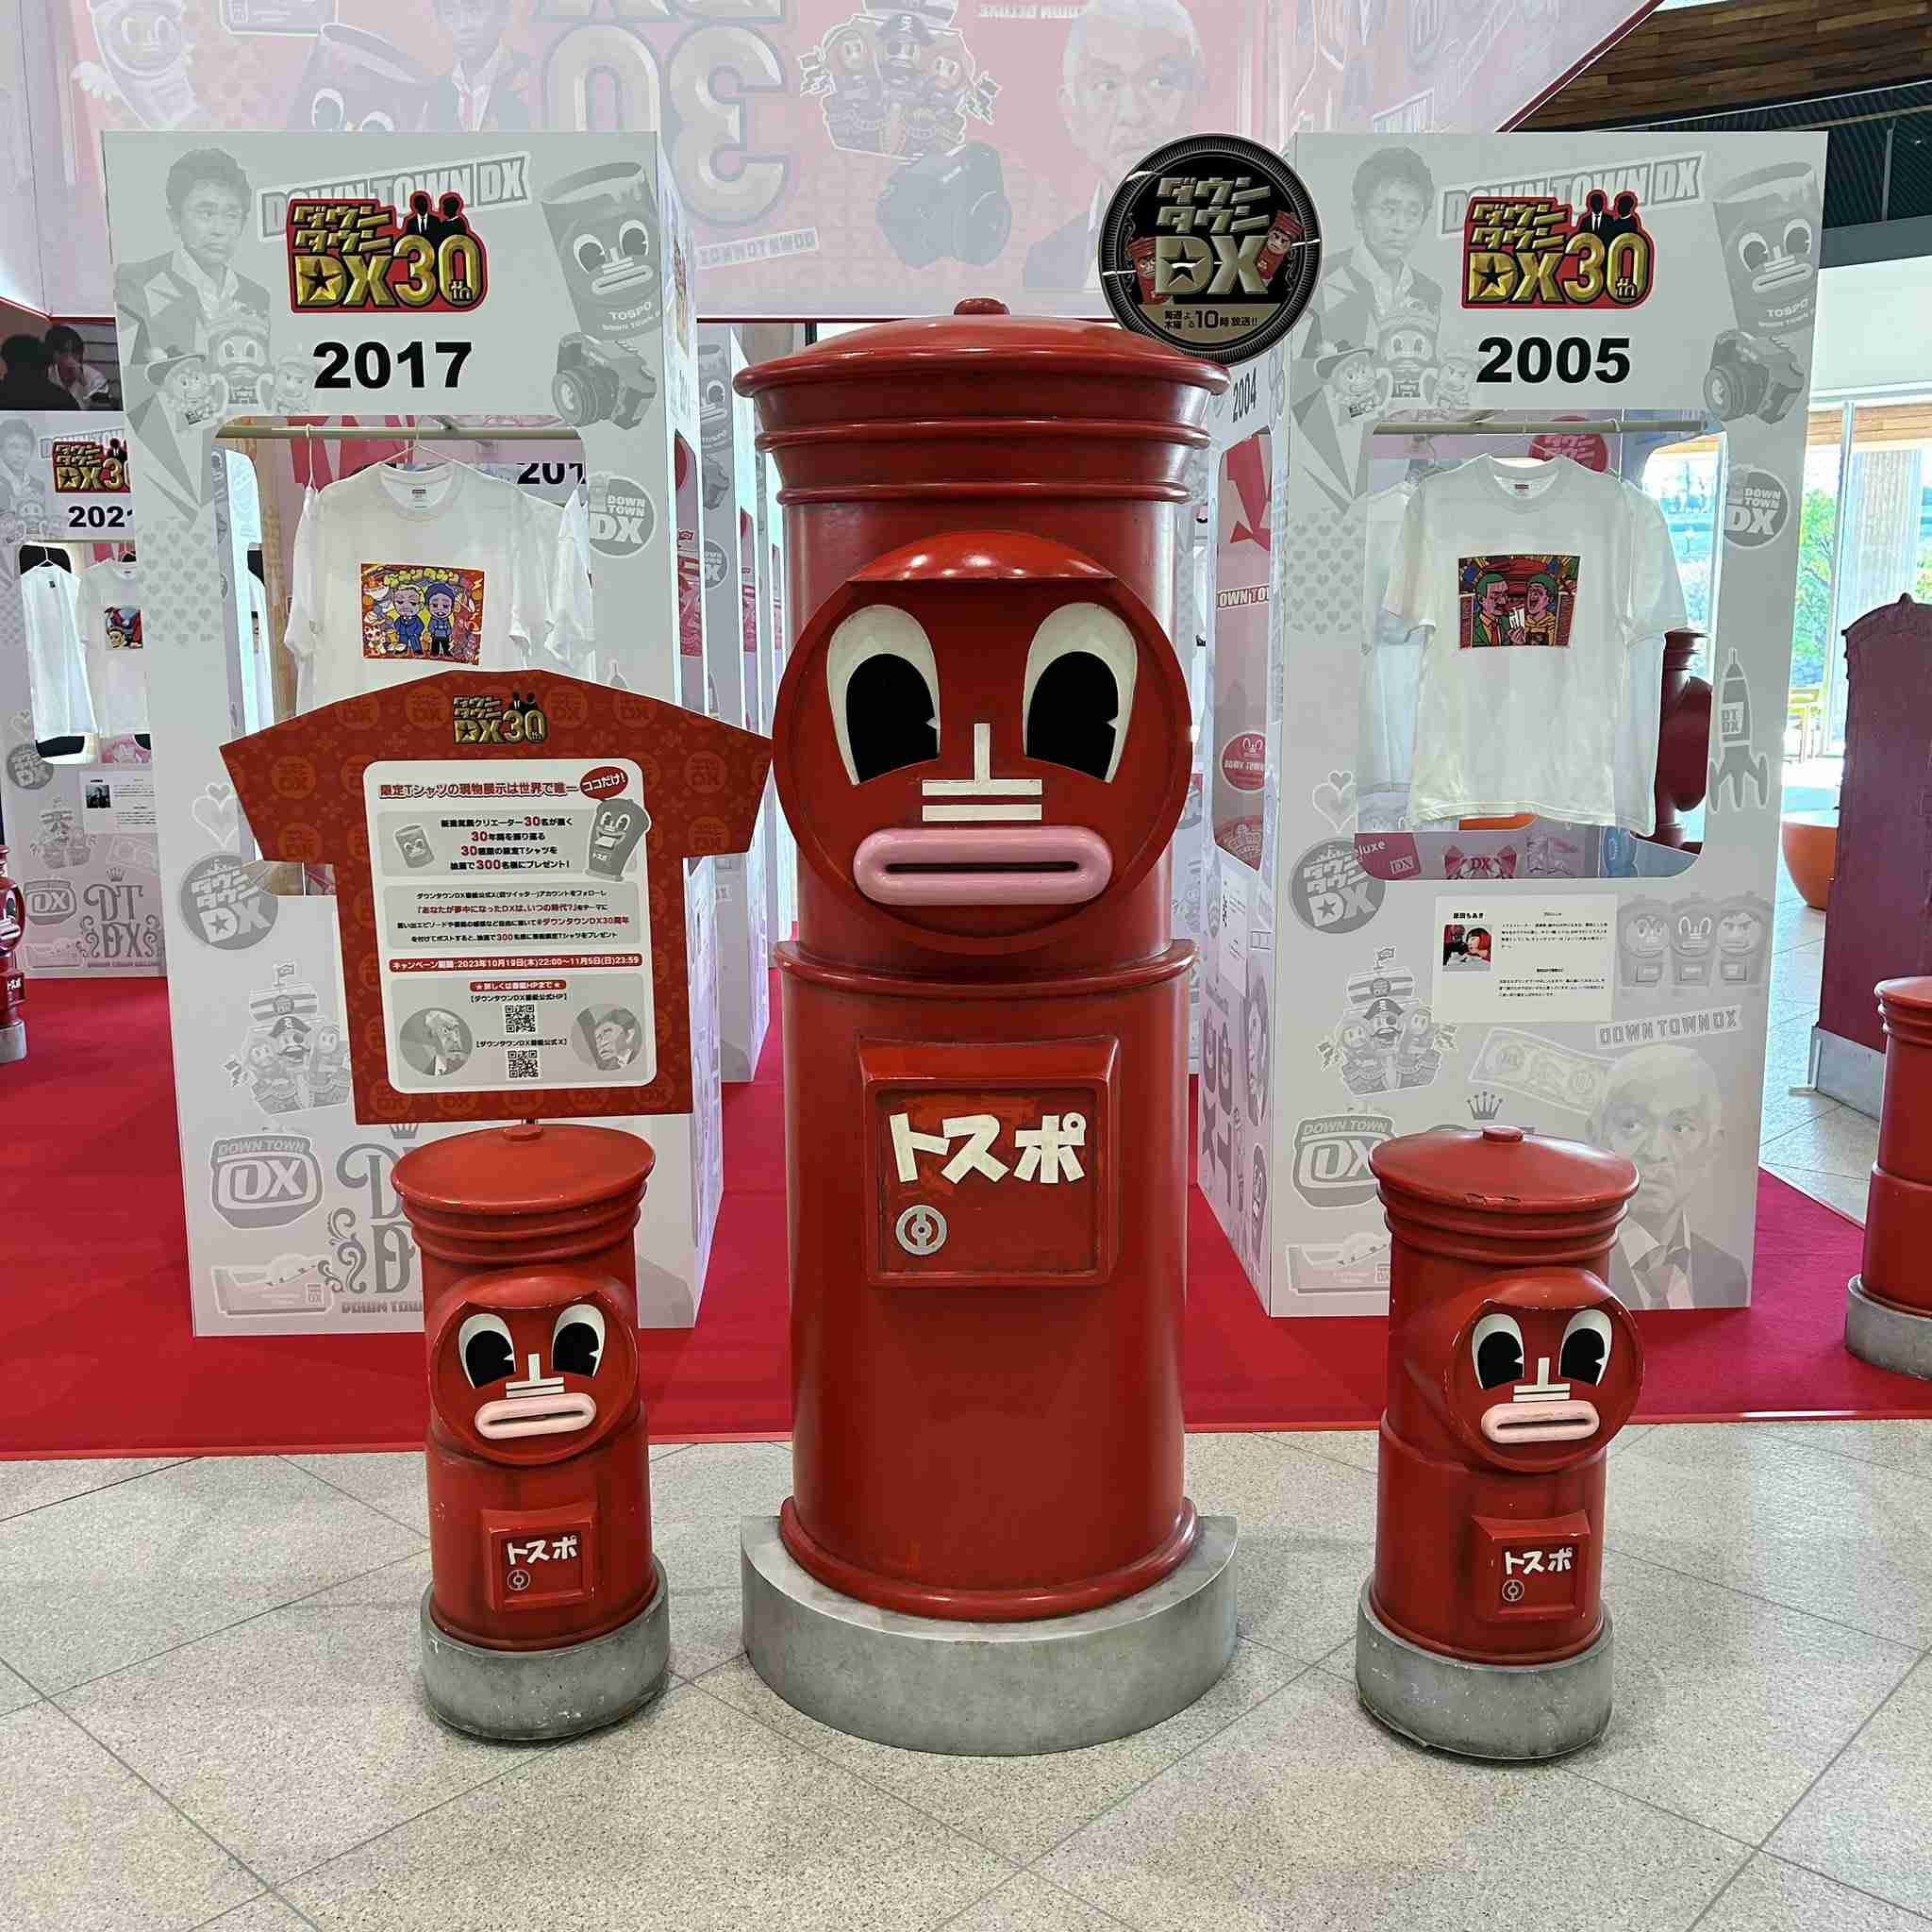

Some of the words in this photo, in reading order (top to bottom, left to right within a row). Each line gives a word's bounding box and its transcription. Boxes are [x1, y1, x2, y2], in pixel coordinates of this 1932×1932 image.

[476, 156, 527, 206] DX
[1156, 176, 1271, 205] ダウン
[1653, 156, 1702, 200] DX
[293, 205, 391, 228] ダウン
[1156, 205, 1270, 234] タウン
[1472, 203, 1568, 226] ダウン
[293, 229, 392, 253] タウン
[1470, 226, 1565, 250] タウン
[1155, 236, 1271, 294] DX
[312, 341, 473, 389] 2017
[1476, 337, 1630, 383] 2005
[1232, 367, 1257, 423] 2004
[57, 458, 130, 491] DX3
[608, 494, 646, 508] DOWN
[1743, 487, 1781, 500] DOWN
[608, 505, 645, 517] TOWN
[1726, 505, 1778, 536] DX
[589, 512, 643, 544] DX
[199, 894, 275, 944] DX
[1307, 881, 1378, 927] DX
[1303, 1119, 1348, 1134] DOWN
[1350, 1119, 1390, 1134] TOWN
[217, 1140, 263, 1156] DOWN
[265, 1139, 306, 1155] TOWN
[890, 1112, 1087, 1184] トスポ
[507, 1535, 577, 1566] トスポ
[1504, 1547, 1573, 1575] トスポ
